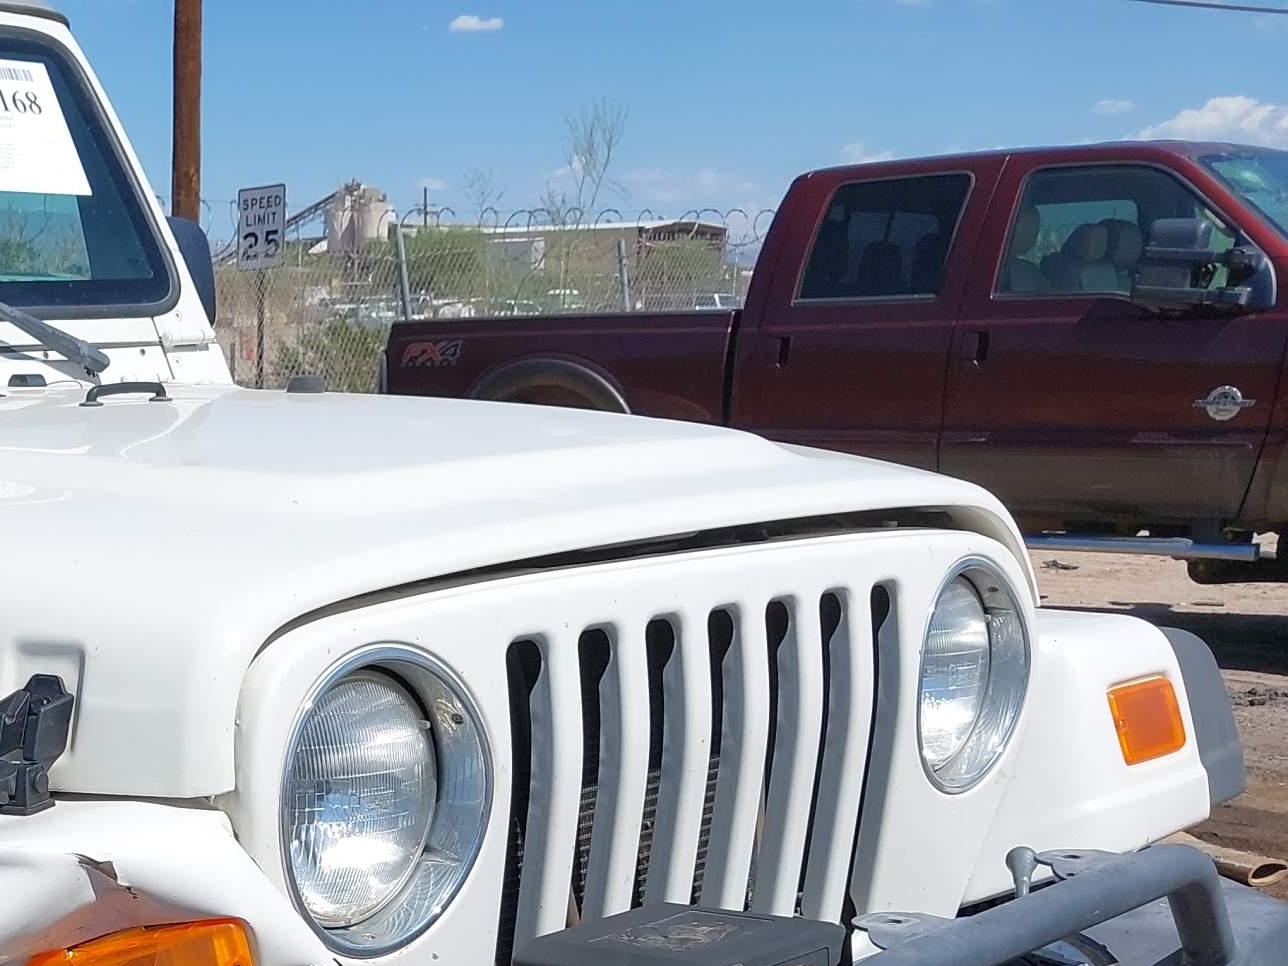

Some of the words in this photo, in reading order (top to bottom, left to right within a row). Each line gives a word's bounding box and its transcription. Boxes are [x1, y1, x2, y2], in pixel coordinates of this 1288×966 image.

[242, 195, 282, 211] SPEED
[246, 212, 277, 227] LIMIT
[241, 229, 280, 261] 25
[401, 340, 464, 362] FX4
